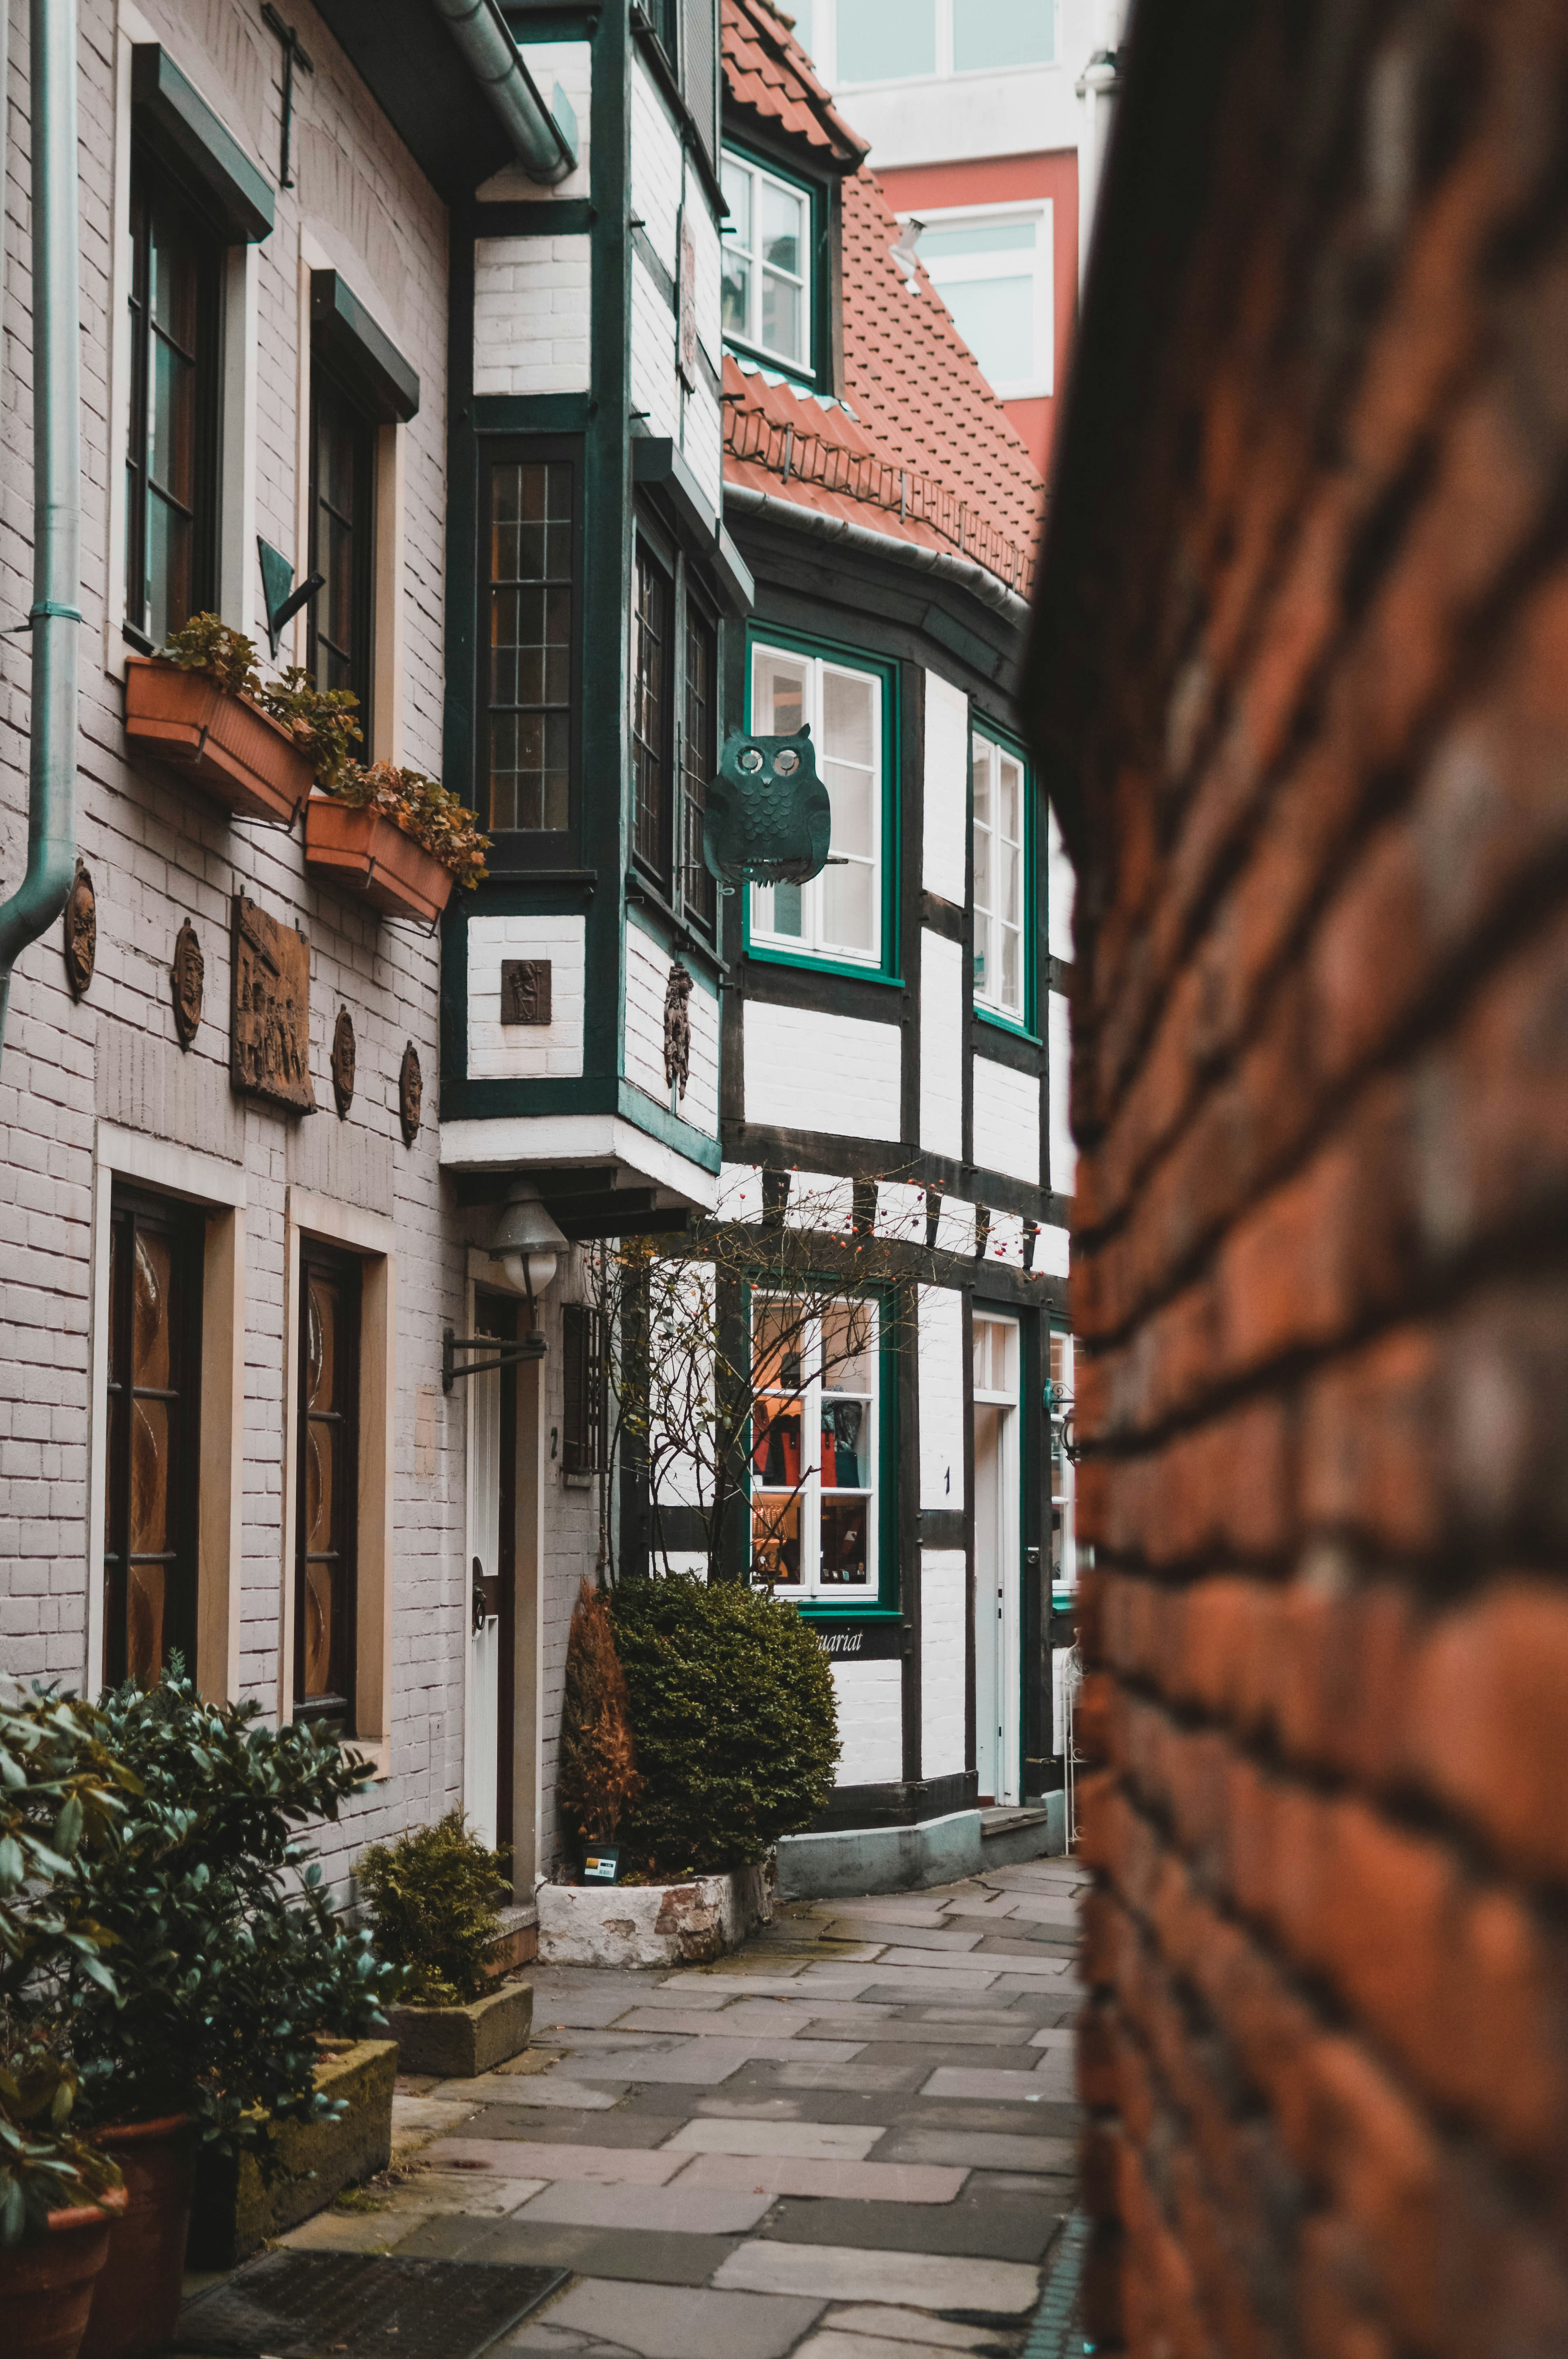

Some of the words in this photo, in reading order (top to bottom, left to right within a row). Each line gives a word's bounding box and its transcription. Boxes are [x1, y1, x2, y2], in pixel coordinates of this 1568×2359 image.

[551, 1426, 558, 1459] 2
[944, 1466, 950, 1494] 1
[816, 1627, 863, 1652] uariat
